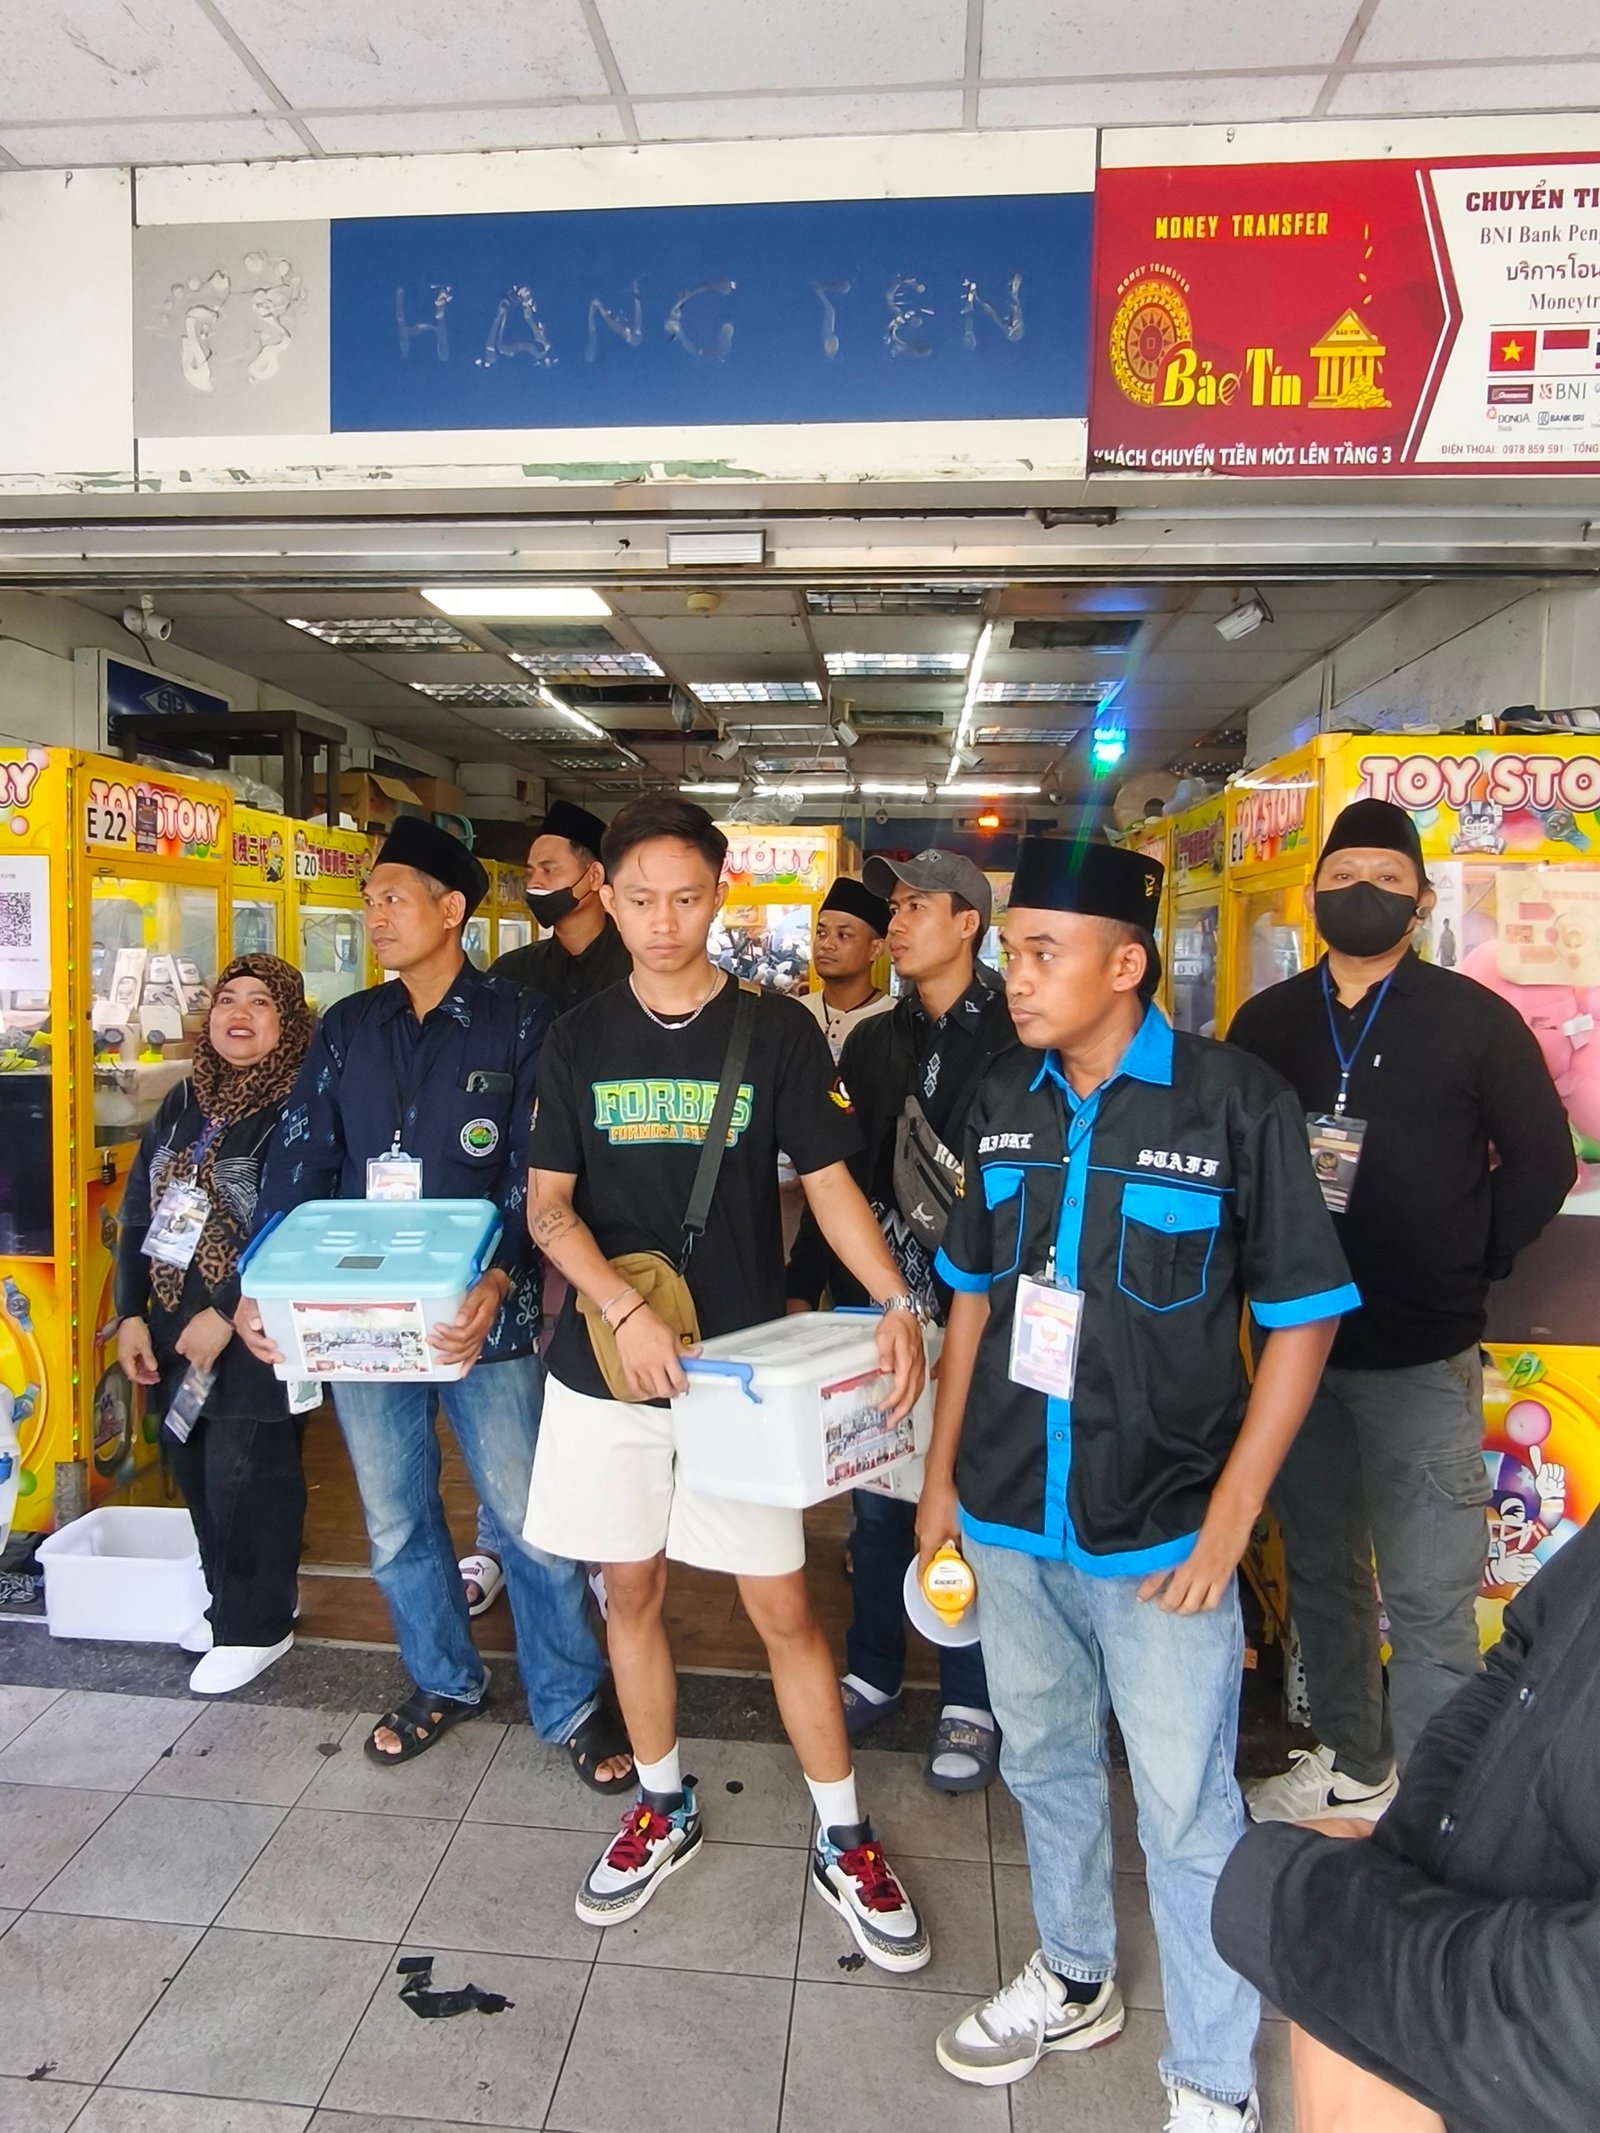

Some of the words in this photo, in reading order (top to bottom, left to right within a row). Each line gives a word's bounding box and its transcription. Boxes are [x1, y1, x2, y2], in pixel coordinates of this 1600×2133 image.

[1465, 178, 1565, 212] CHUYỂN
[1155, 215, 1219, 239] MONEY
[1231, 212, 1329, 238] TRANSFER
[1480, 226, 1512, 245] BNI
[1519, 224, 1562, 244] Bank
[1568, 224, 1600, 245] Pen
[1116, 264, 1147, 296] MONEY
[1149, 262, 1191, 294] TRANSFER
[397, 279, 740, 370] HANG
[813, 272, 1027, 359] TEN
[1246, 348, 1302, 407] Tín
[1555, 382, 1587, 400] BNI
[1261, 441, 1295, 465] MỜI
[1299, 440, 1329, 465] LÊN
[1382, 445, 1392, 465] 3
[1502, 443, 1525, 455] 0978
[1527, 443, 1545, 454] 859
[1547, 442, 1564, 454] 591
[1359, 755, 1482, 811] TOY
[1489, 755, 1600, 812] STO
[87, 807, 98, 839] E
[104, 810, 128, 842] 22
[304, 855, 317, 877] 20
[722, 841, 818, 875] TORY
[611, 1123, 678, 1141] FORMOSA
[1136, 1148, 1220, 1178] STAFF
